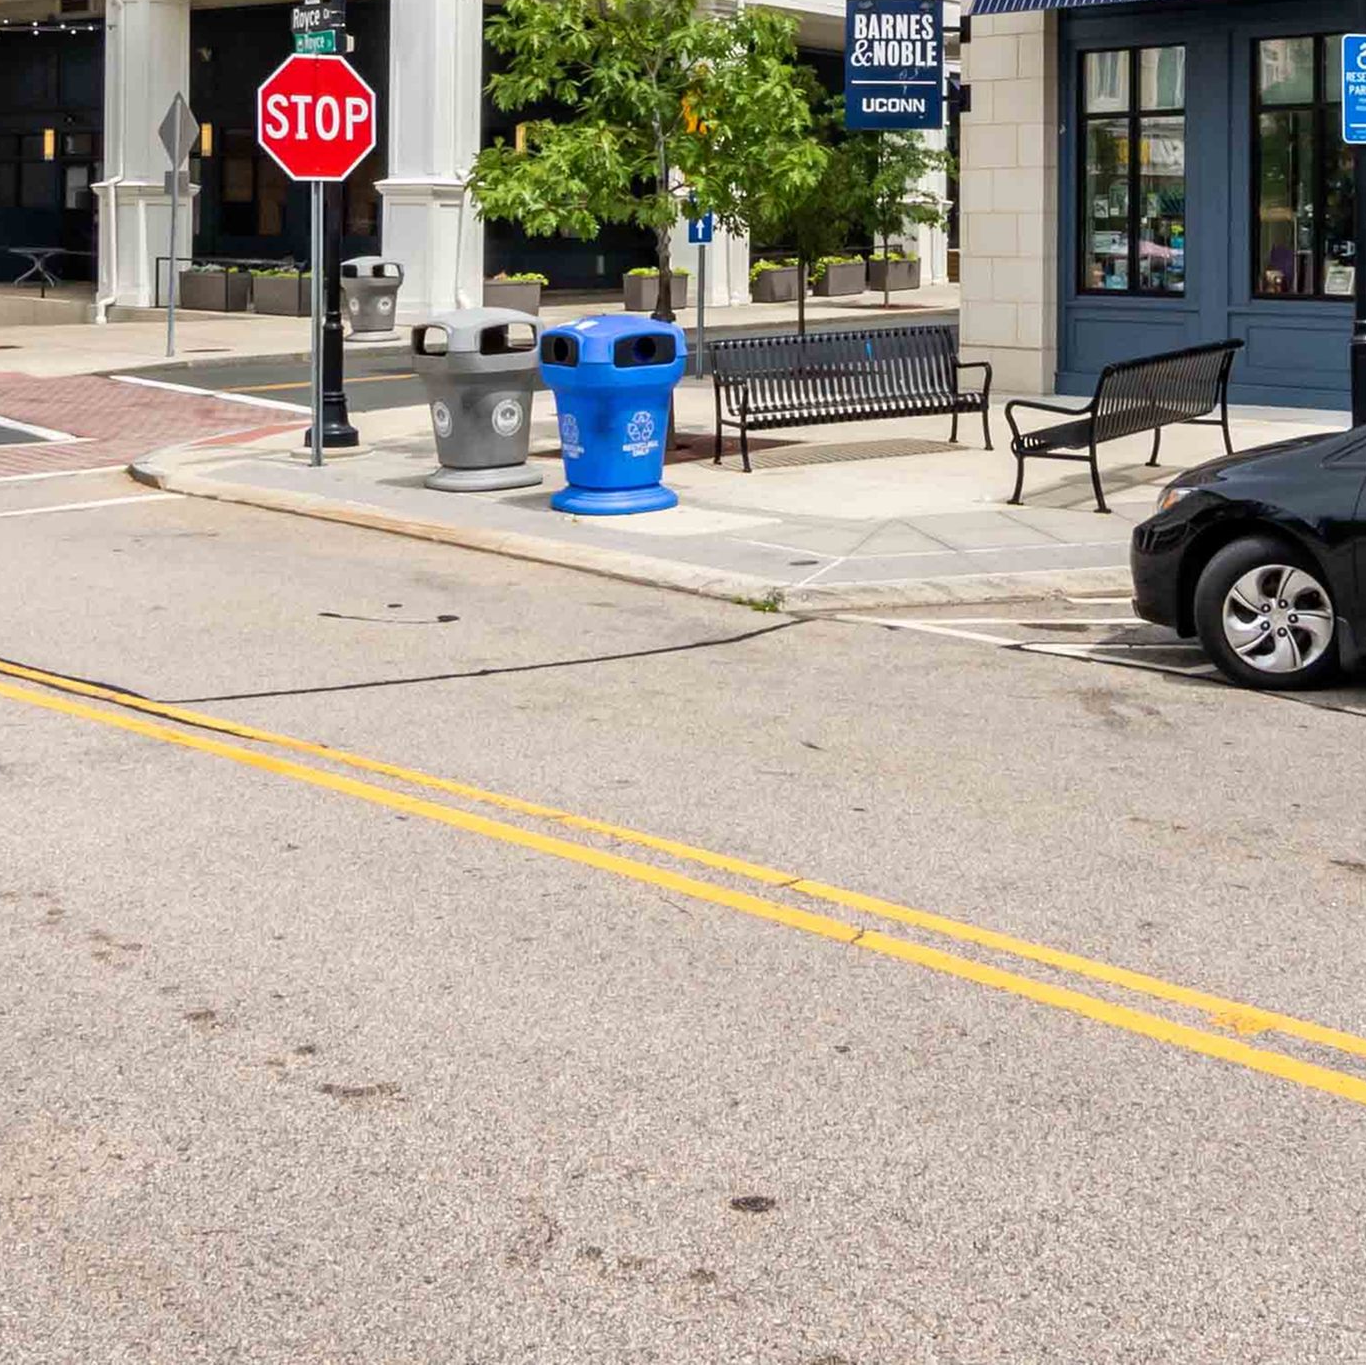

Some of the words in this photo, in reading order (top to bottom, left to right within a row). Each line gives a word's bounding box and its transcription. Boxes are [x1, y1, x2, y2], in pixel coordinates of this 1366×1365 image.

[293, 8, 321, 32] Royce
[854, 14, 934, 40] BARNES
[265, 94, 368, 141] STOP
[862, 98, 925, 113] UCONN
